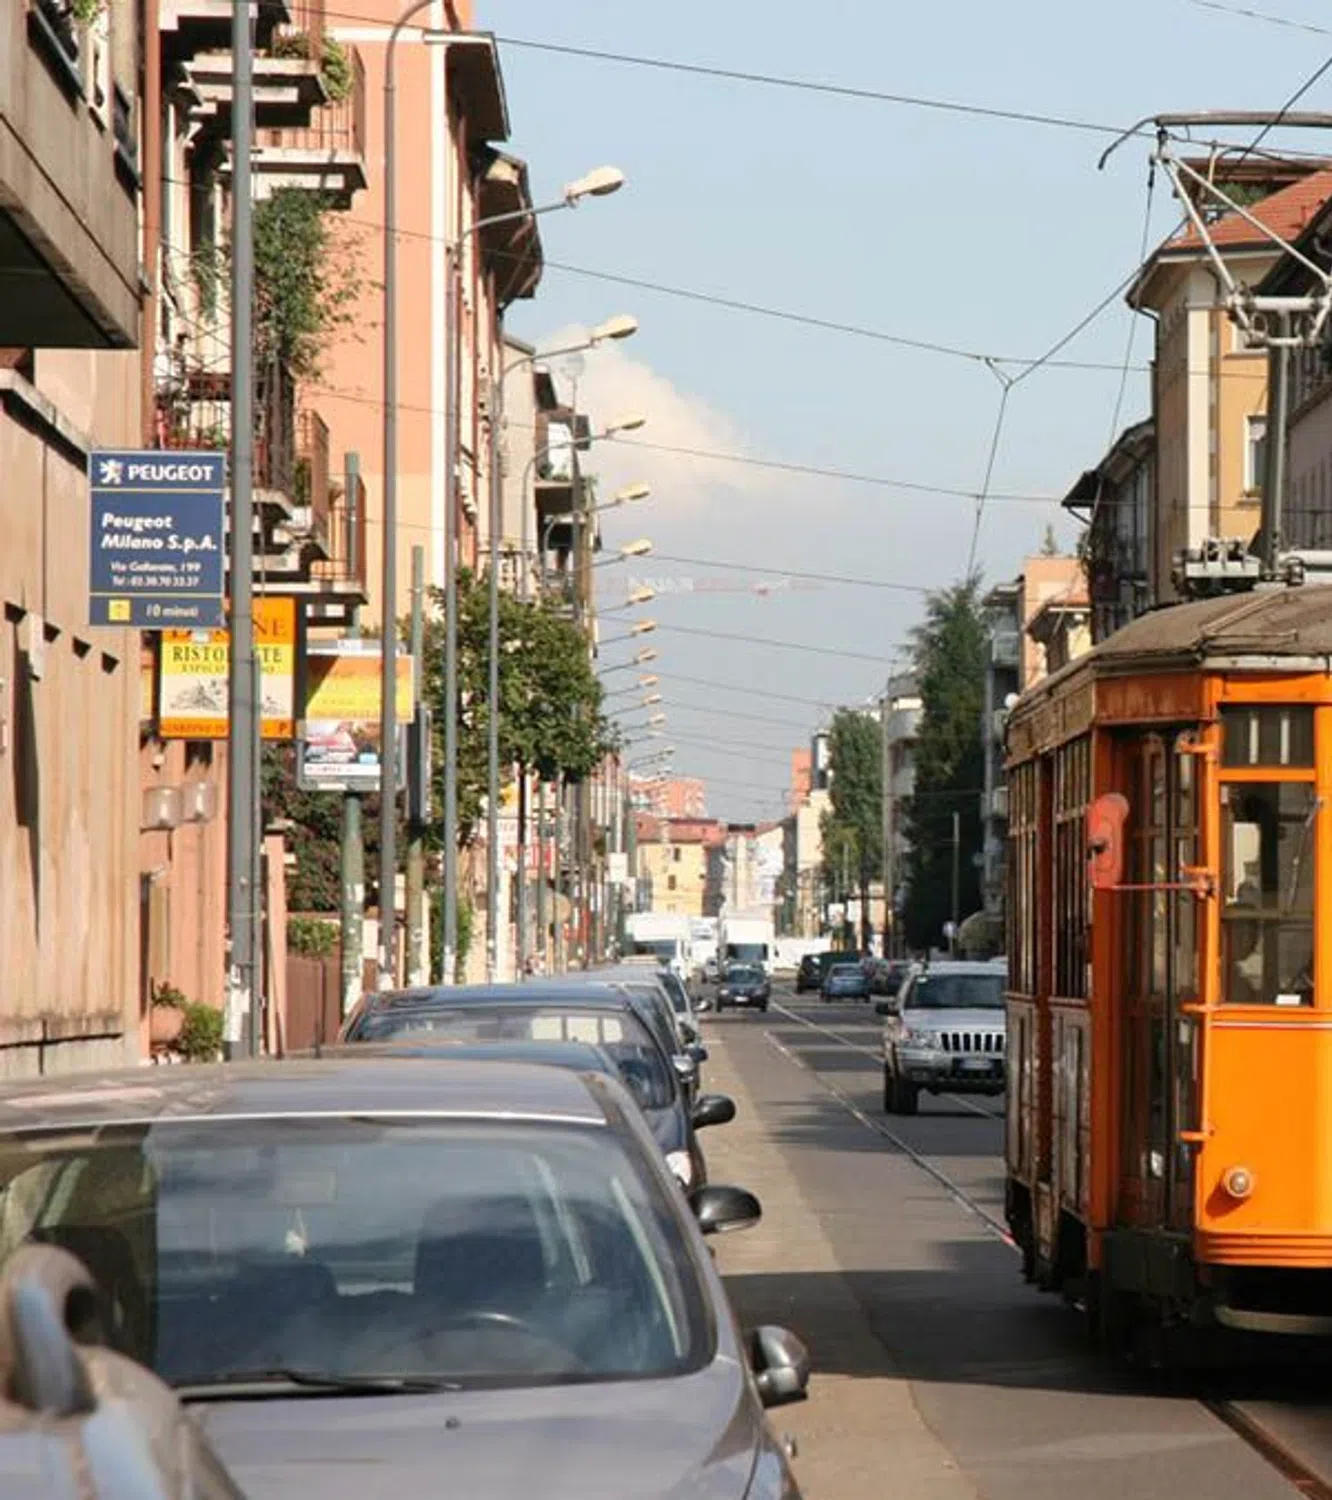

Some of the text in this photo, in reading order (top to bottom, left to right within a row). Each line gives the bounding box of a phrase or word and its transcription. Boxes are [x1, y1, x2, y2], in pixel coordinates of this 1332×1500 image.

[128, 464, 213, 480] PEUGEOT
[102, 512, 173, 531] Peugeot
[101, 535, 218, 553] Milano S.p.A.
[146, 603, 199, 617] 10 minuti
[173, 645, 283, 662] RISTOTE
